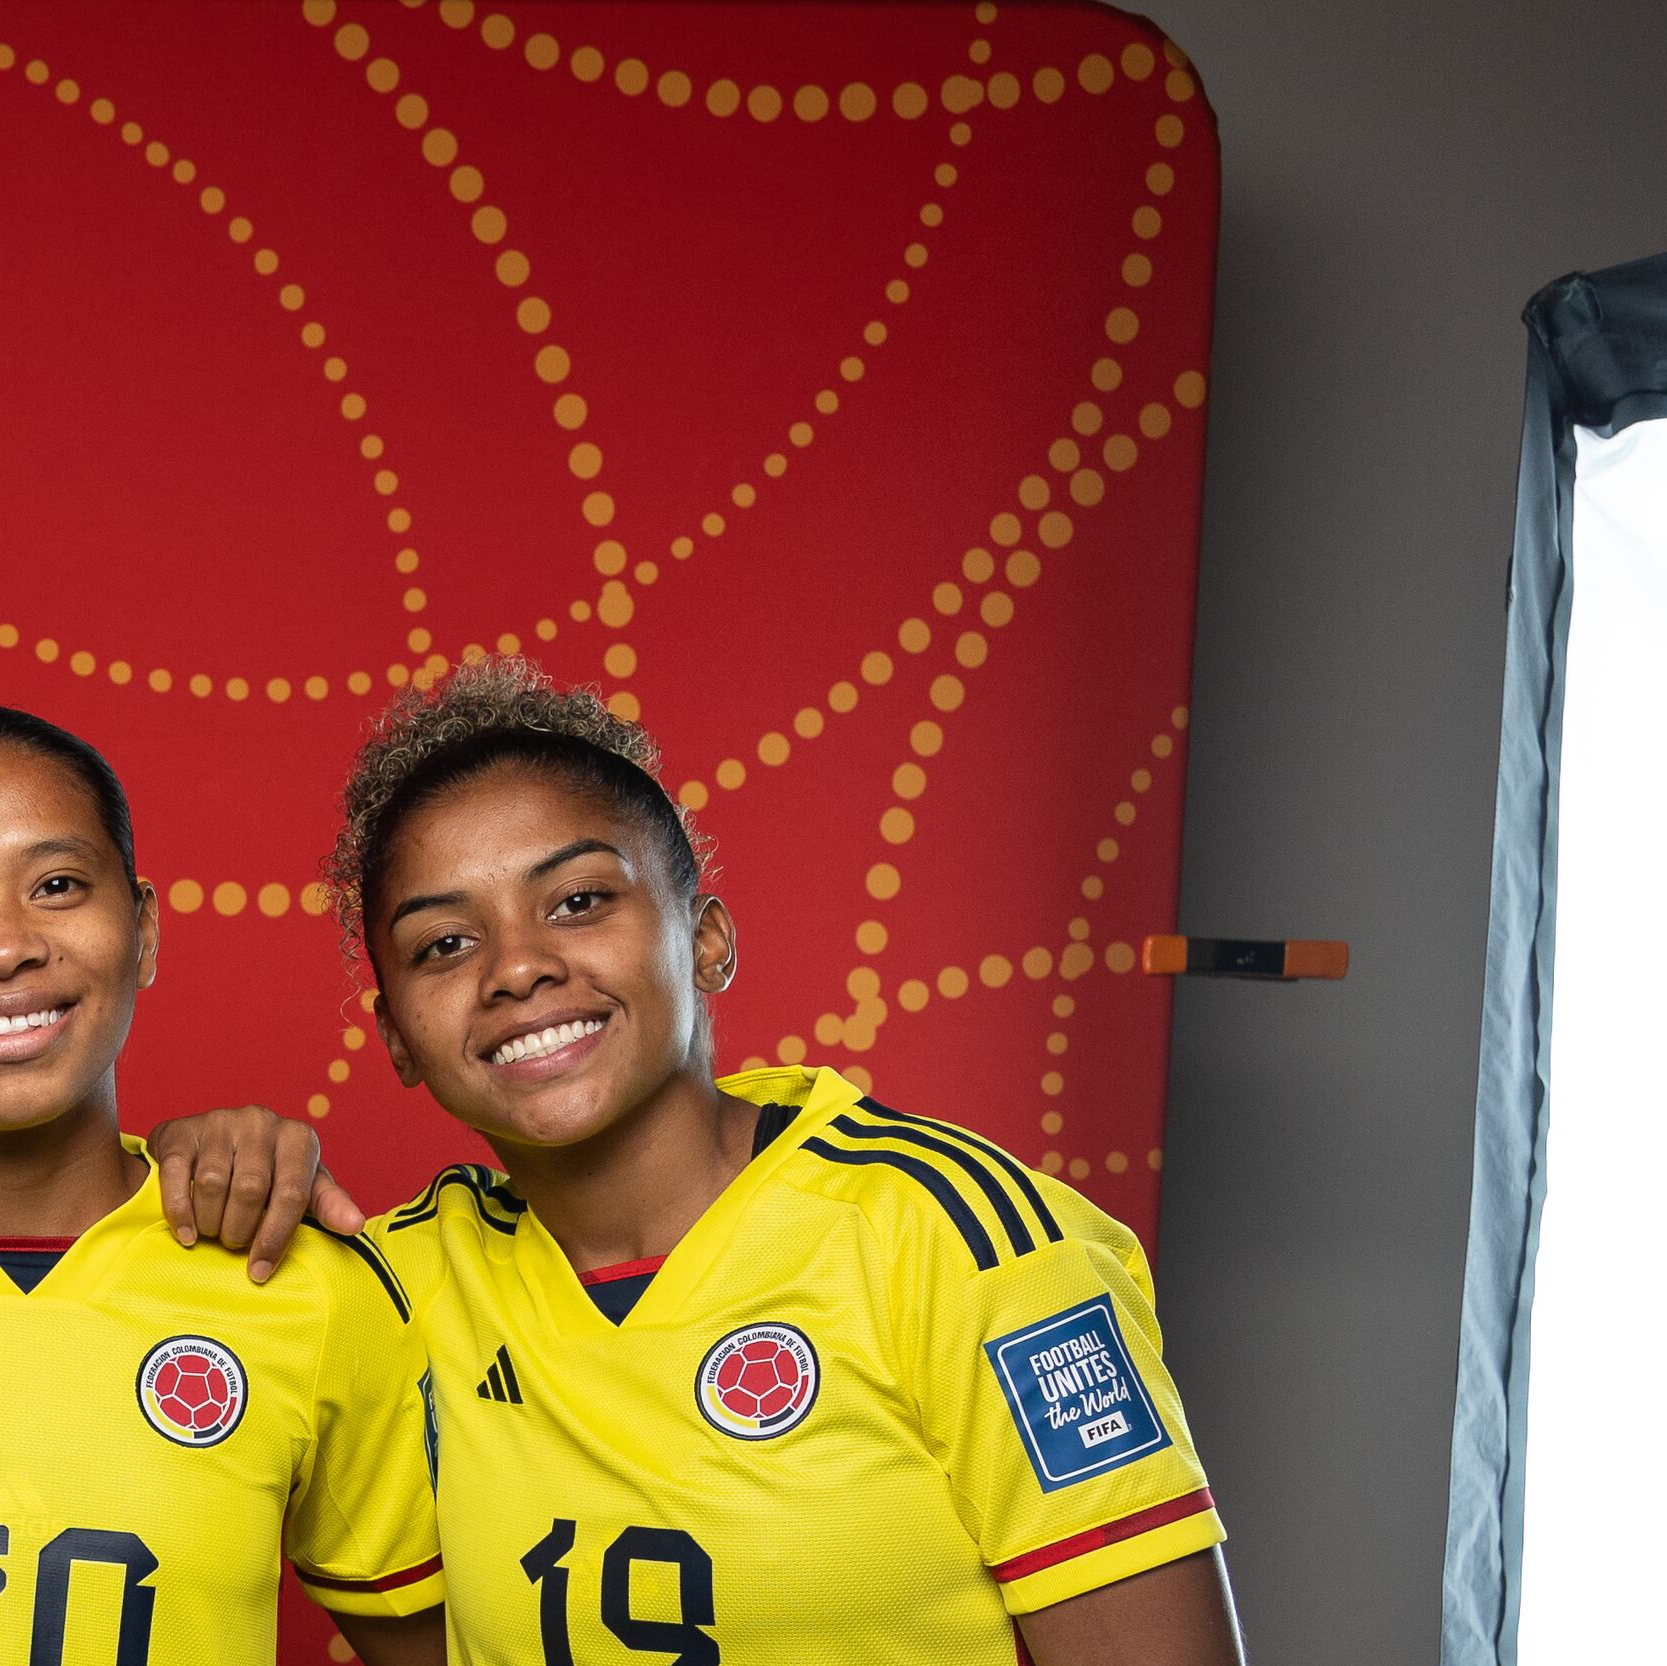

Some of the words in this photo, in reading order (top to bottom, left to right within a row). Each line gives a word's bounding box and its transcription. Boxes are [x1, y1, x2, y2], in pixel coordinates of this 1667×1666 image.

[217, 1357, 227, 1368] DE
[786, 1338, 797, 1348] DE
[793, 1346, 809, 1373] FUTBOL
[1029, 1330, 1105, 1375] FOOTBALL
[1038, 1350, 1117, 1403] UNITES
[1044, 1401, 1081, 1429] the
[1079, 1376, 1131, 1416] World
[1087, 1419, 1121, 1440] FIFA
